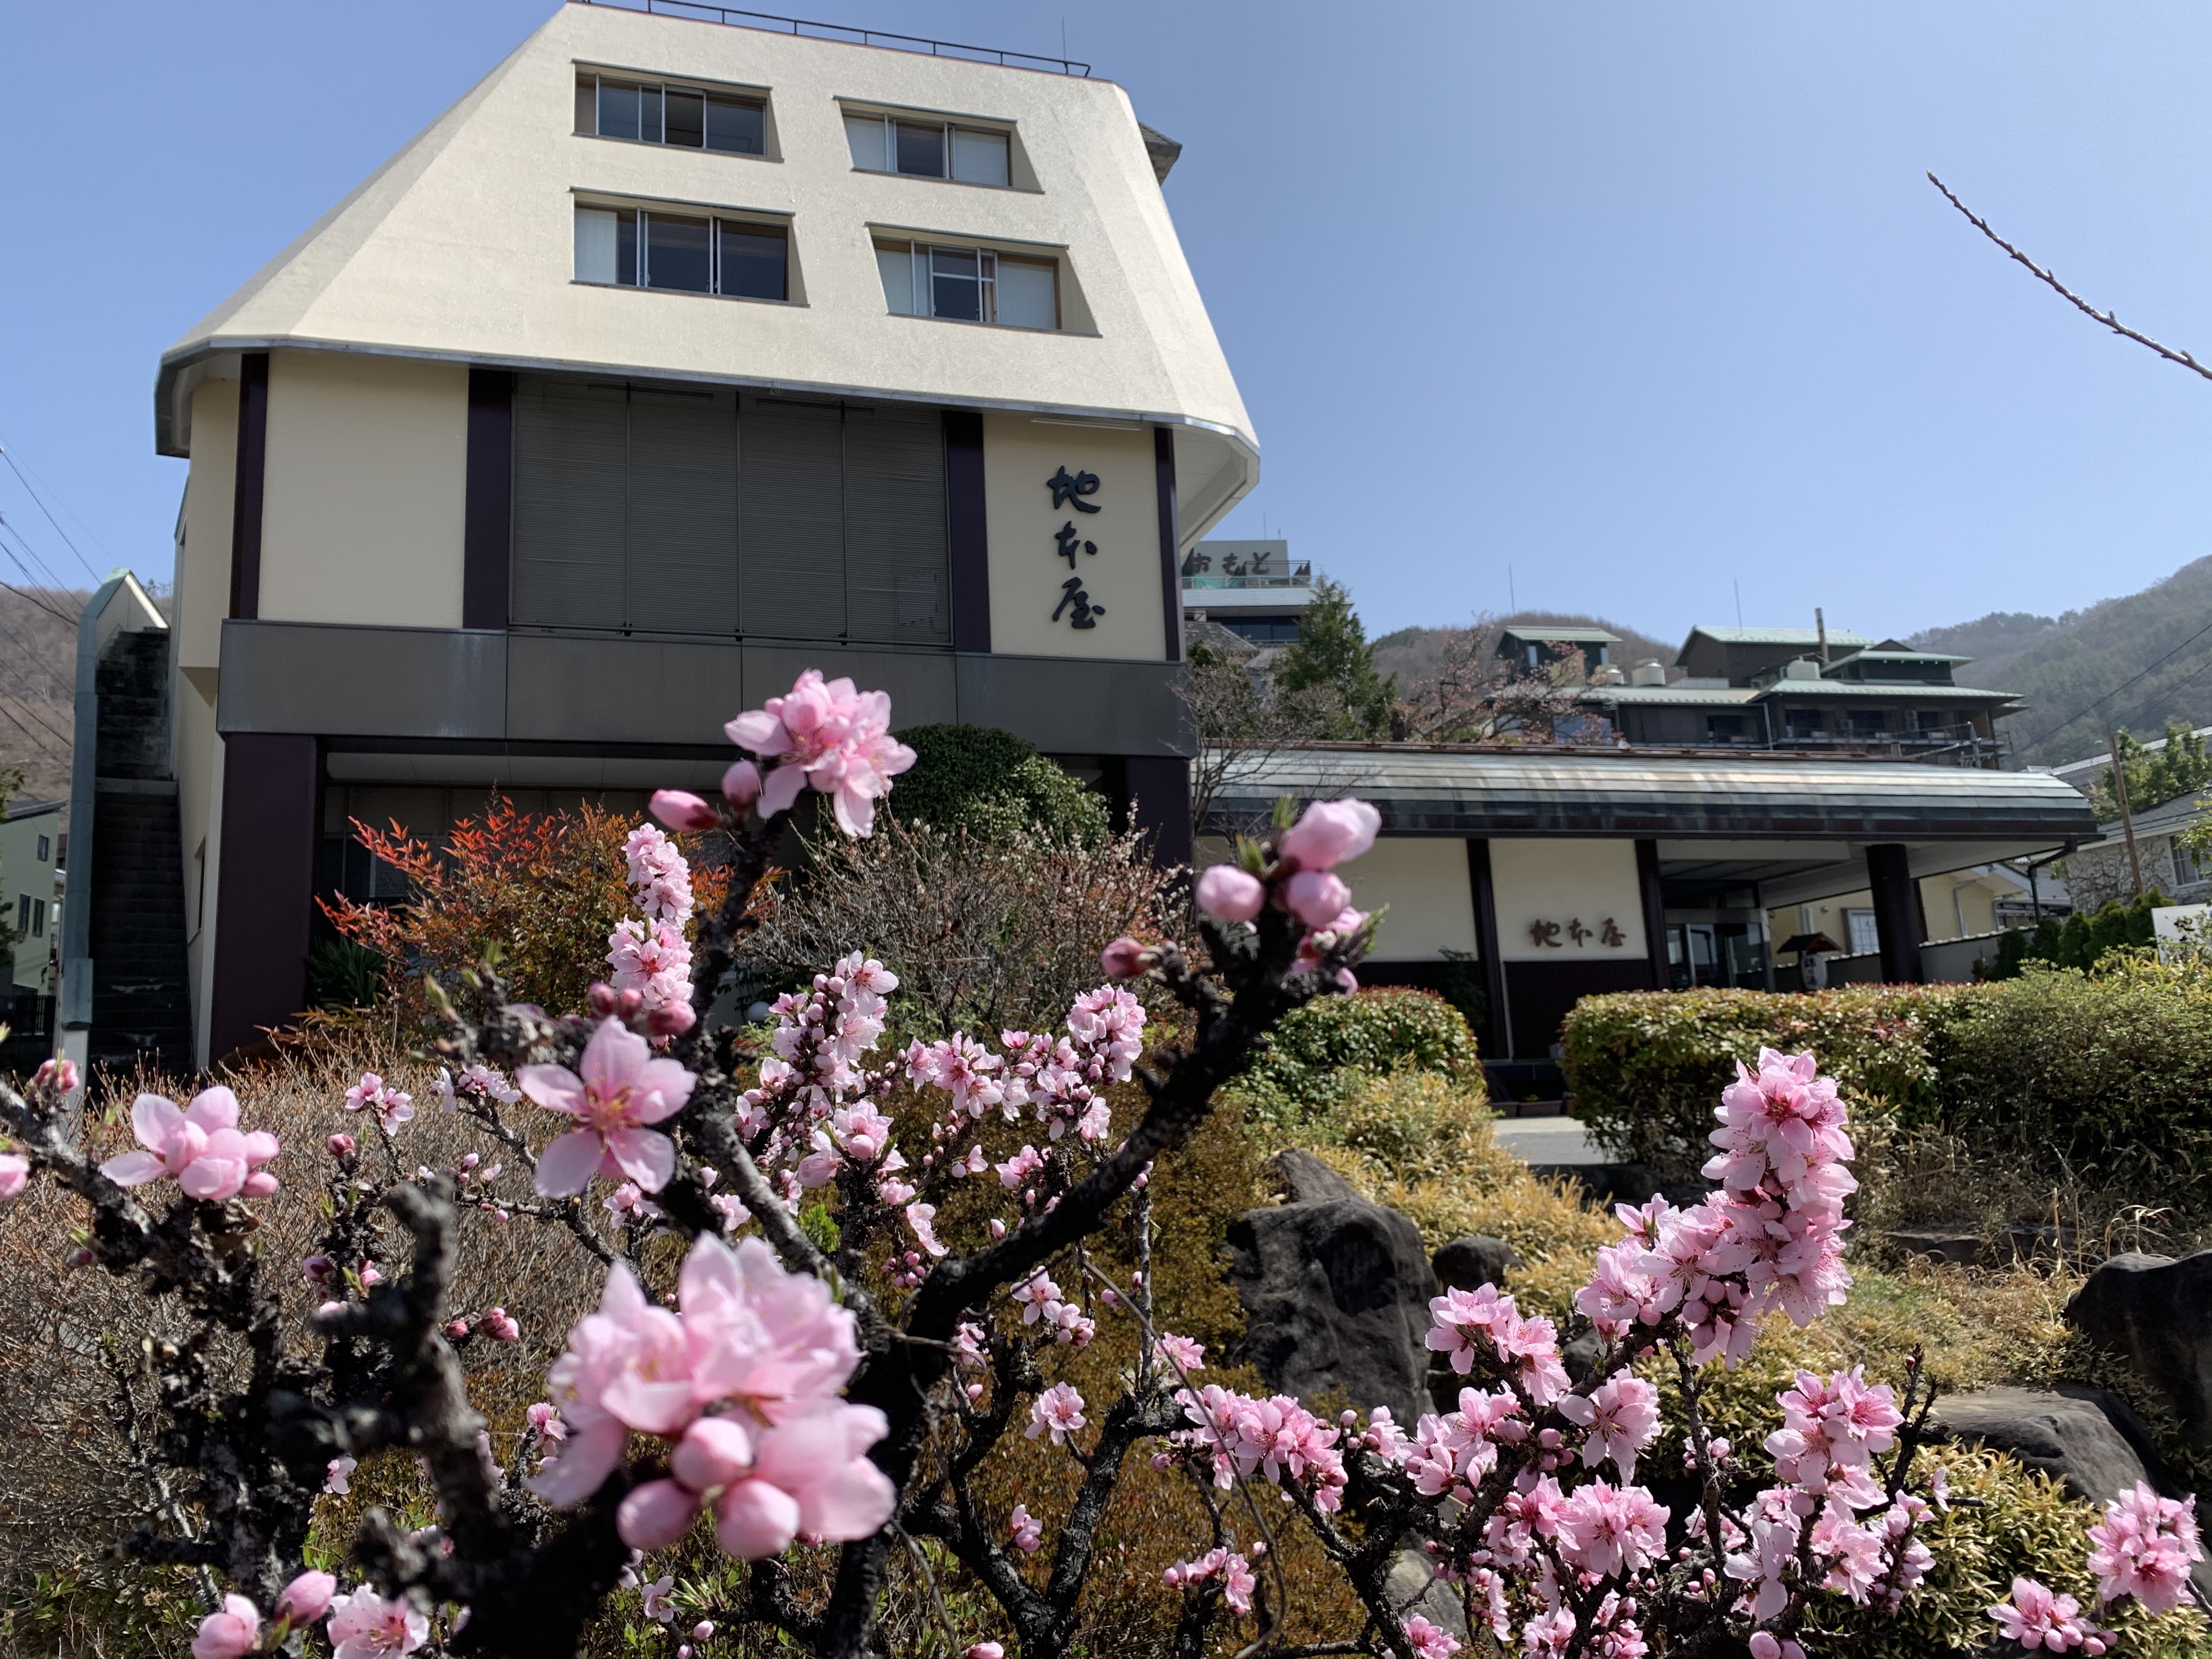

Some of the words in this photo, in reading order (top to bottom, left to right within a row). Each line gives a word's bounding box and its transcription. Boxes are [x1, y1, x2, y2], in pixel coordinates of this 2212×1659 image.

[1046, 465, 1105, 629] 地本屋
[1529, 917, 1627, 947] 地本屋
